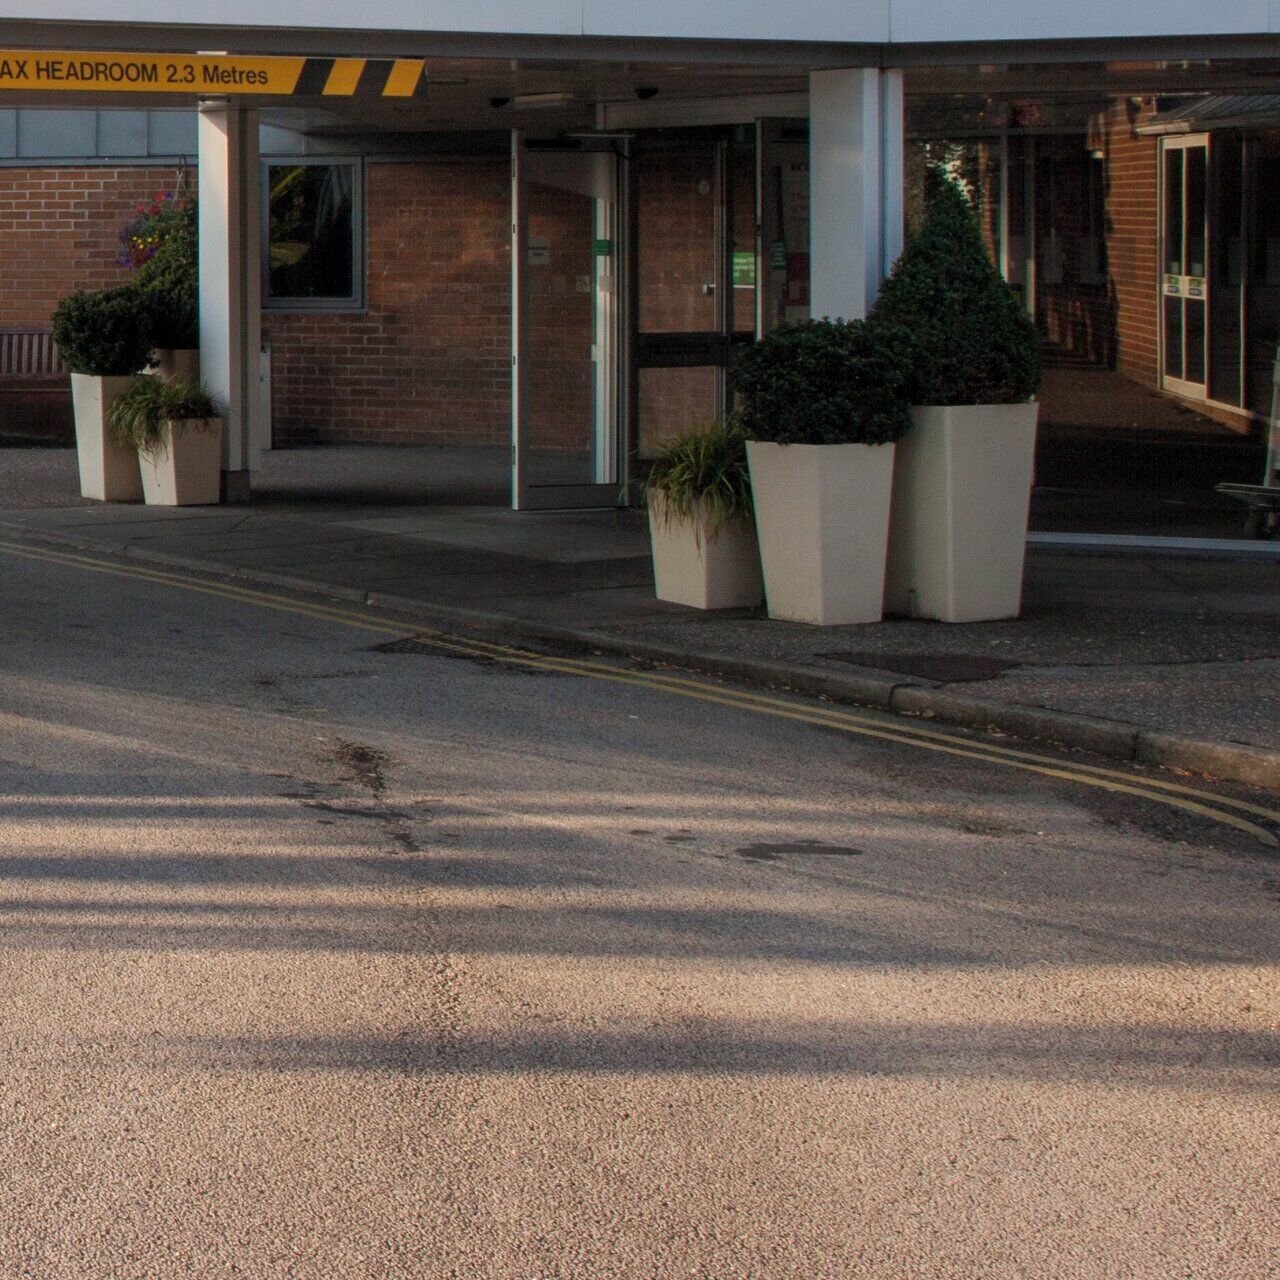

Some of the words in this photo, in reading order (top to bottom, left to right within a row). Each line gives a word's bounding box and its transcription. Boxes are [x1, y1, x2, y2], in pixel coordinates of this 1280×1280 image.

[35, 61, 158, 83] HEADROOM
[166, 64, 196, 83] 2.3
[202, 64, 269, 85] Metres
